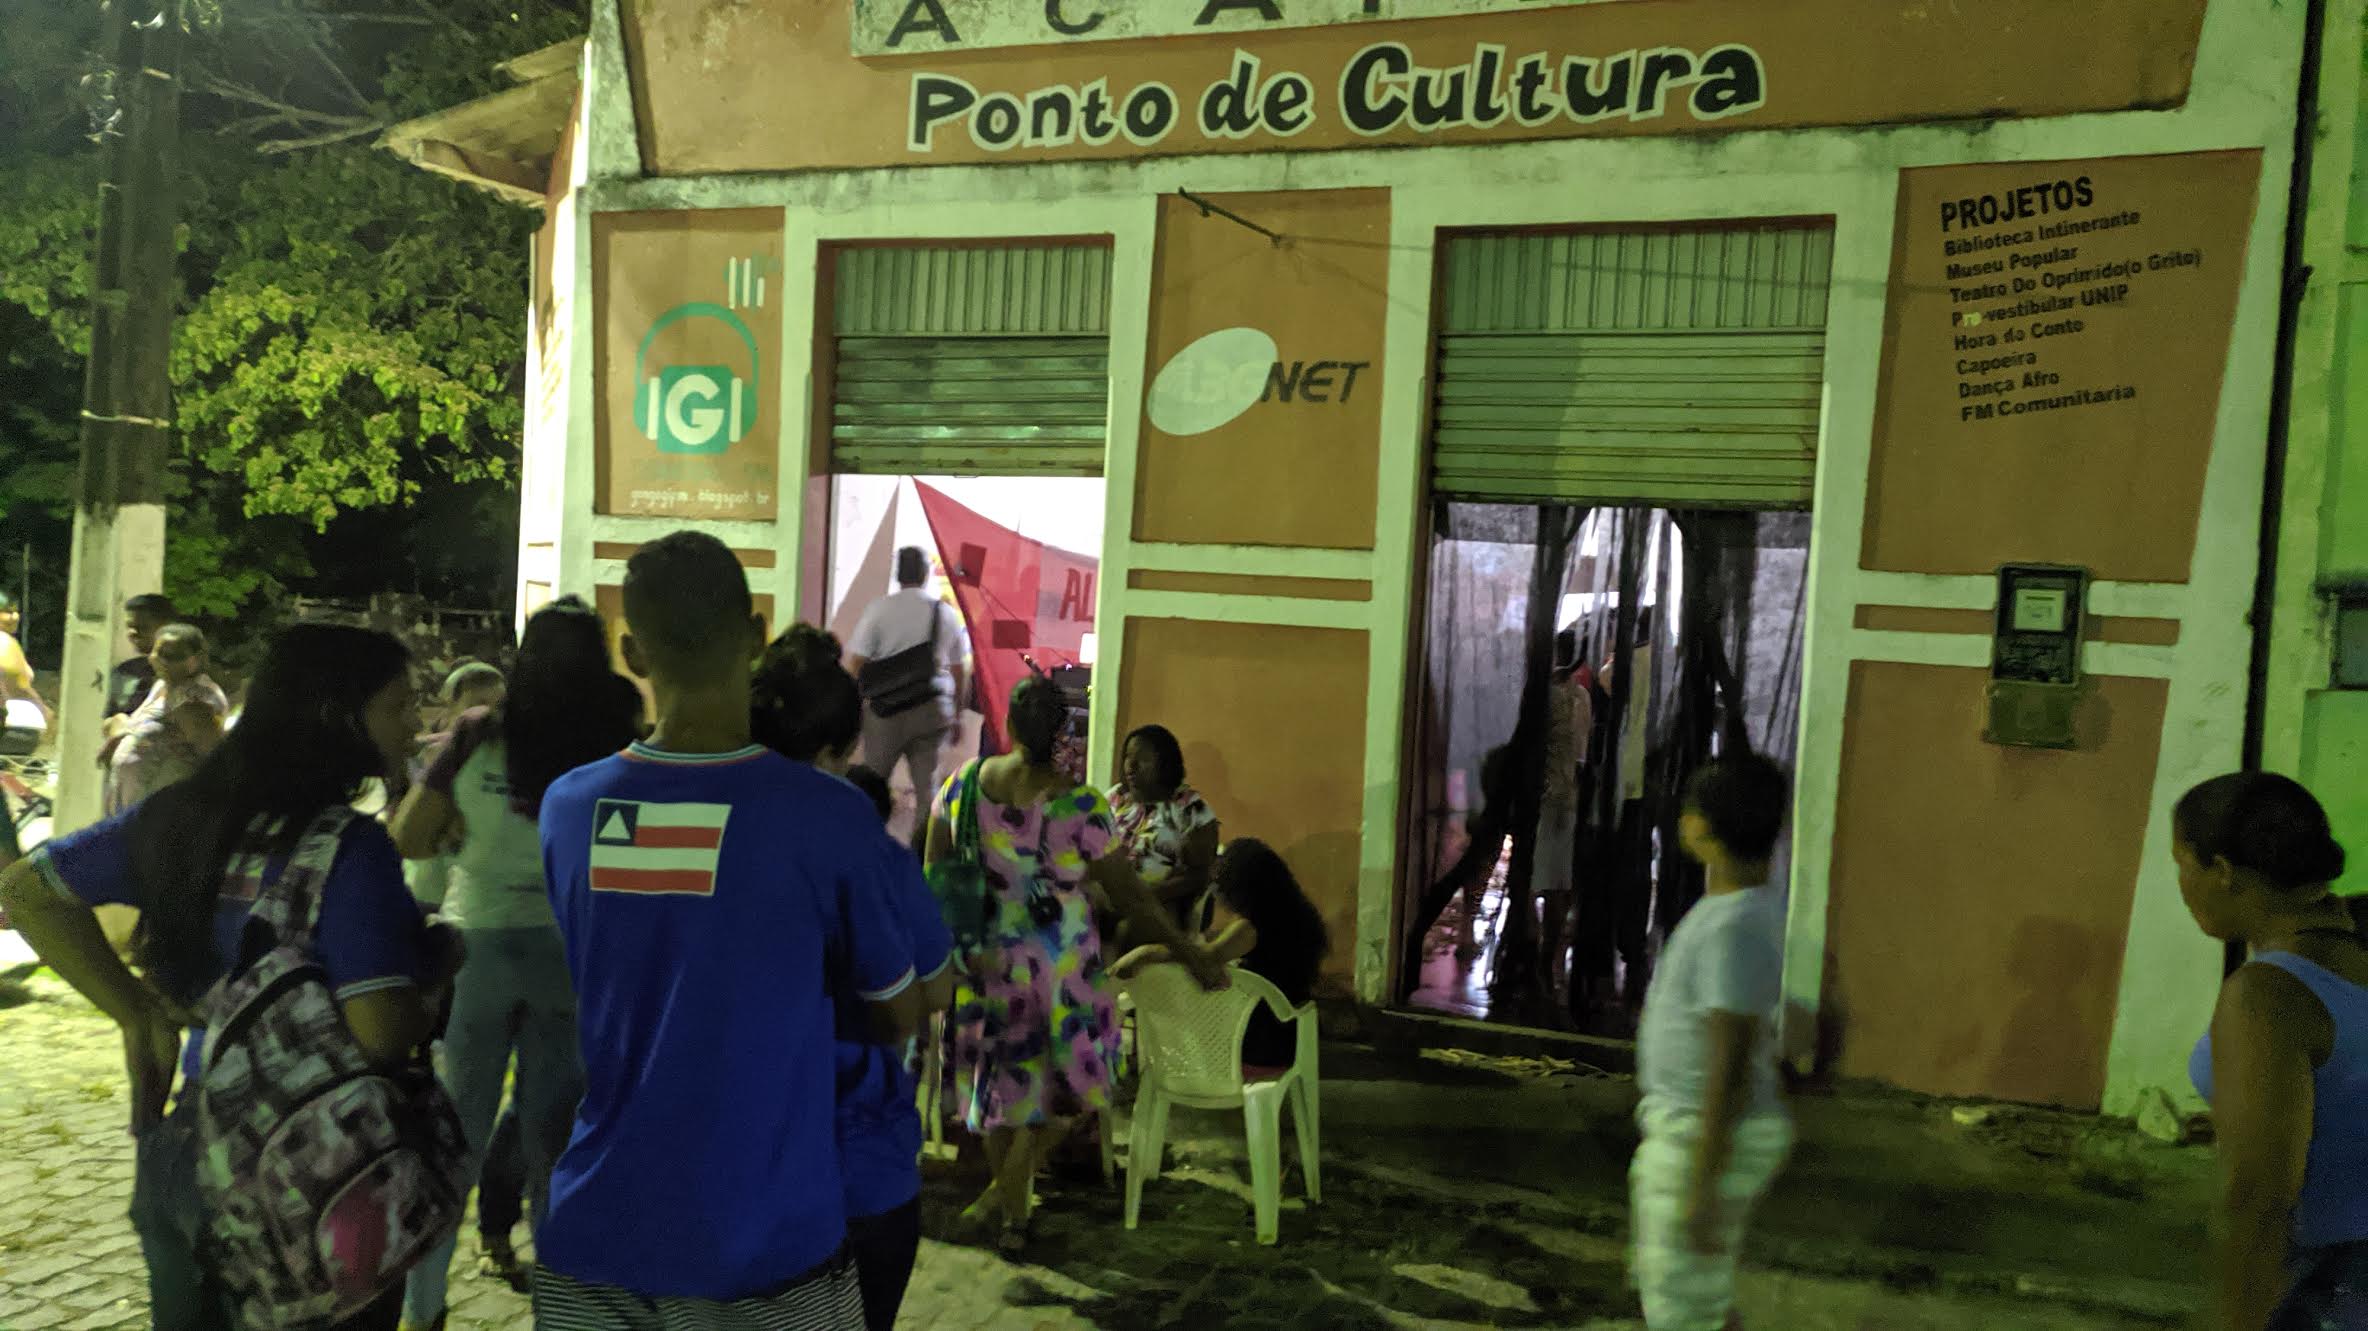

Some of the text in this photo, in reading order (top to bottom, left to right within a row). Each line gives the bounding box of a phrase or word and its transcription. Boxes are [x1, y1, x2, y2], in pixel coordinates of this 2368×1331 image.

[908, 40, 1767, 152] Ponto de Cultura
[1941, 176, 2094, 232] PROJETOS
[1944, 231, 2034, 256] Biblioteca
[1946, 246, 2079, 280] Museu Popular
[1950, 284, 2007, 303] Teatro
[2012, 277, 2036, 294] Do
[2081, 283, 2129, 306] UNIP
[1954, 333, 1997, 351] Hora
[2031, 319, 2084, 338] Conto
[1957, 351, 2037, 375] Capoeira
[1959, 371, 2060, 399] Dança Afro
[1962, 403, 1994, 421] FM
